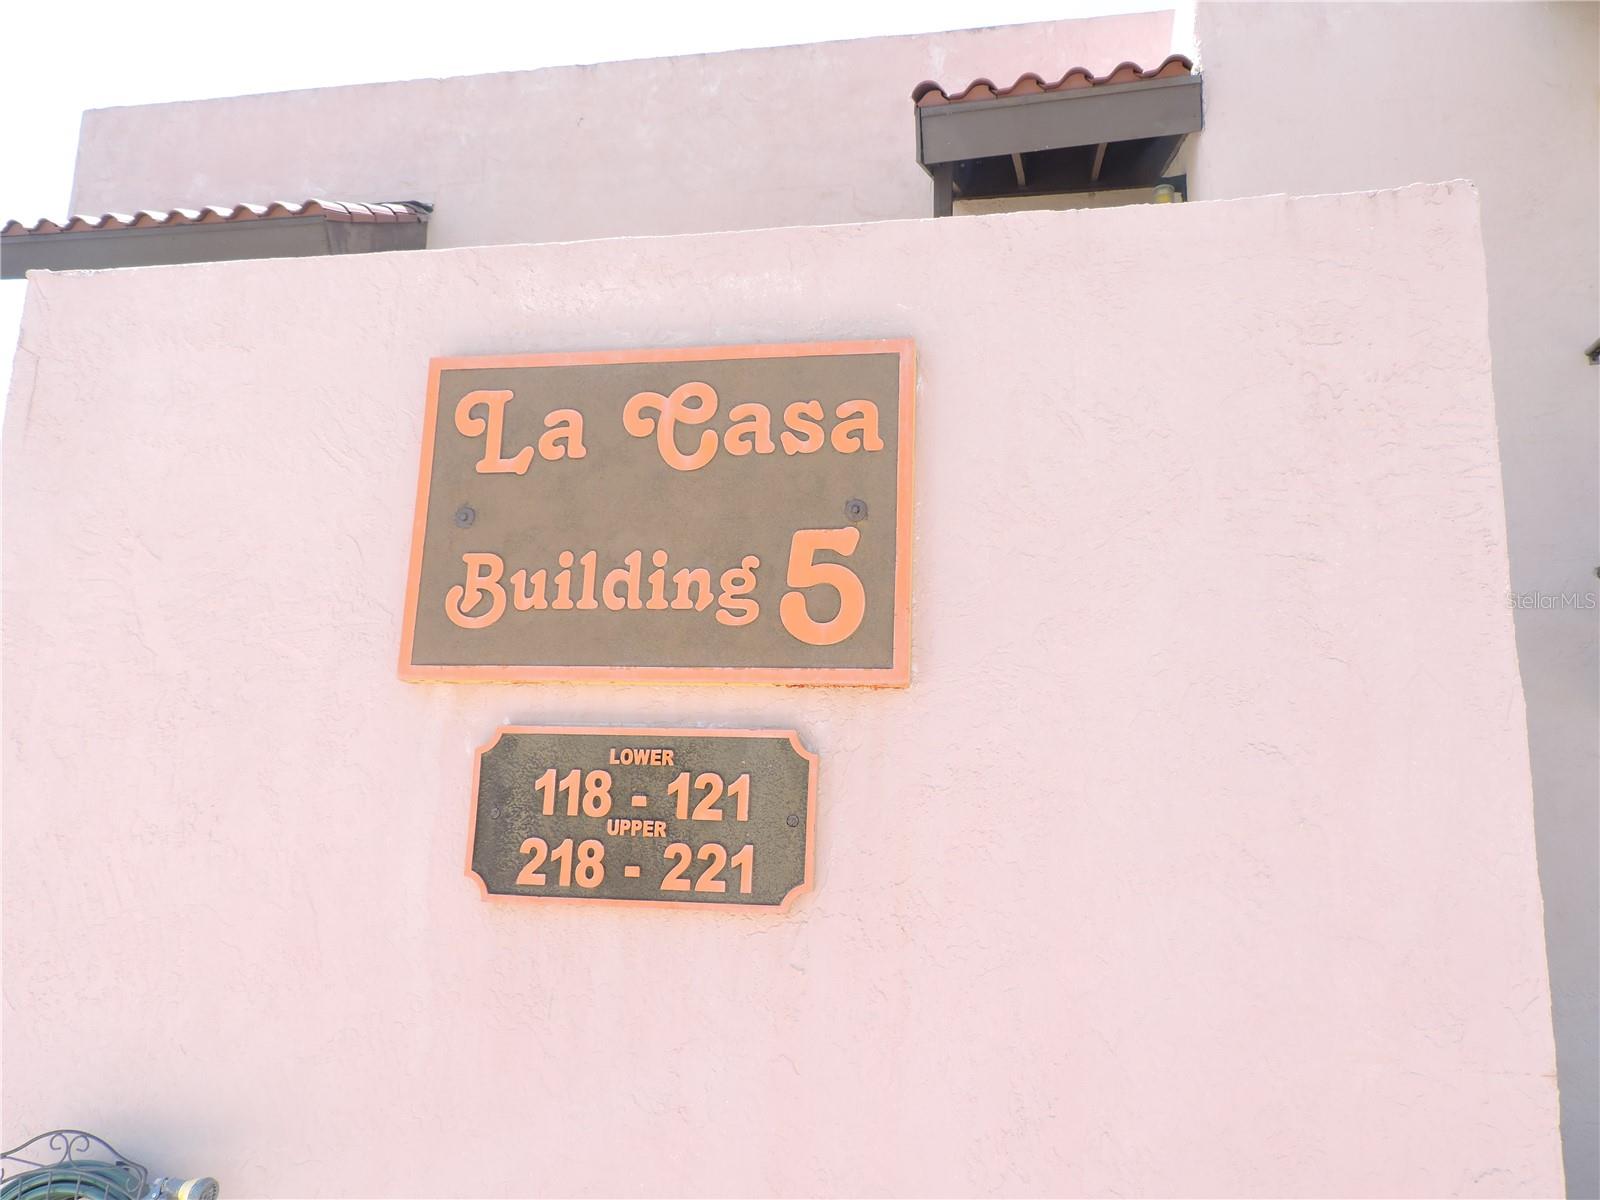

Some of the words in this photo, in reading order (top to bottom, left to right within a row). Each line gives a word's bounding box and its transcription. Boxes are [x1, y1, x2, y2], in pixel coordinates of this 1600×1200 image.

[454, 389, 587, 476] La
[622, 381, 885, 472] Casa
[444, 549, 760, 630] Building
[779, 526, 866, 646] 5
[609, 748, 674, 767] LOWER
[534, 768, 612, 818] 118
[631, 795, 648, 807] -
[667, 772, 750, 822] 121
[606, 818, 667, 838] UPPER
[515, 837, 605, 889] 218
[624, 865, 641, 878] -
[660, 842, 754, 894] 221
